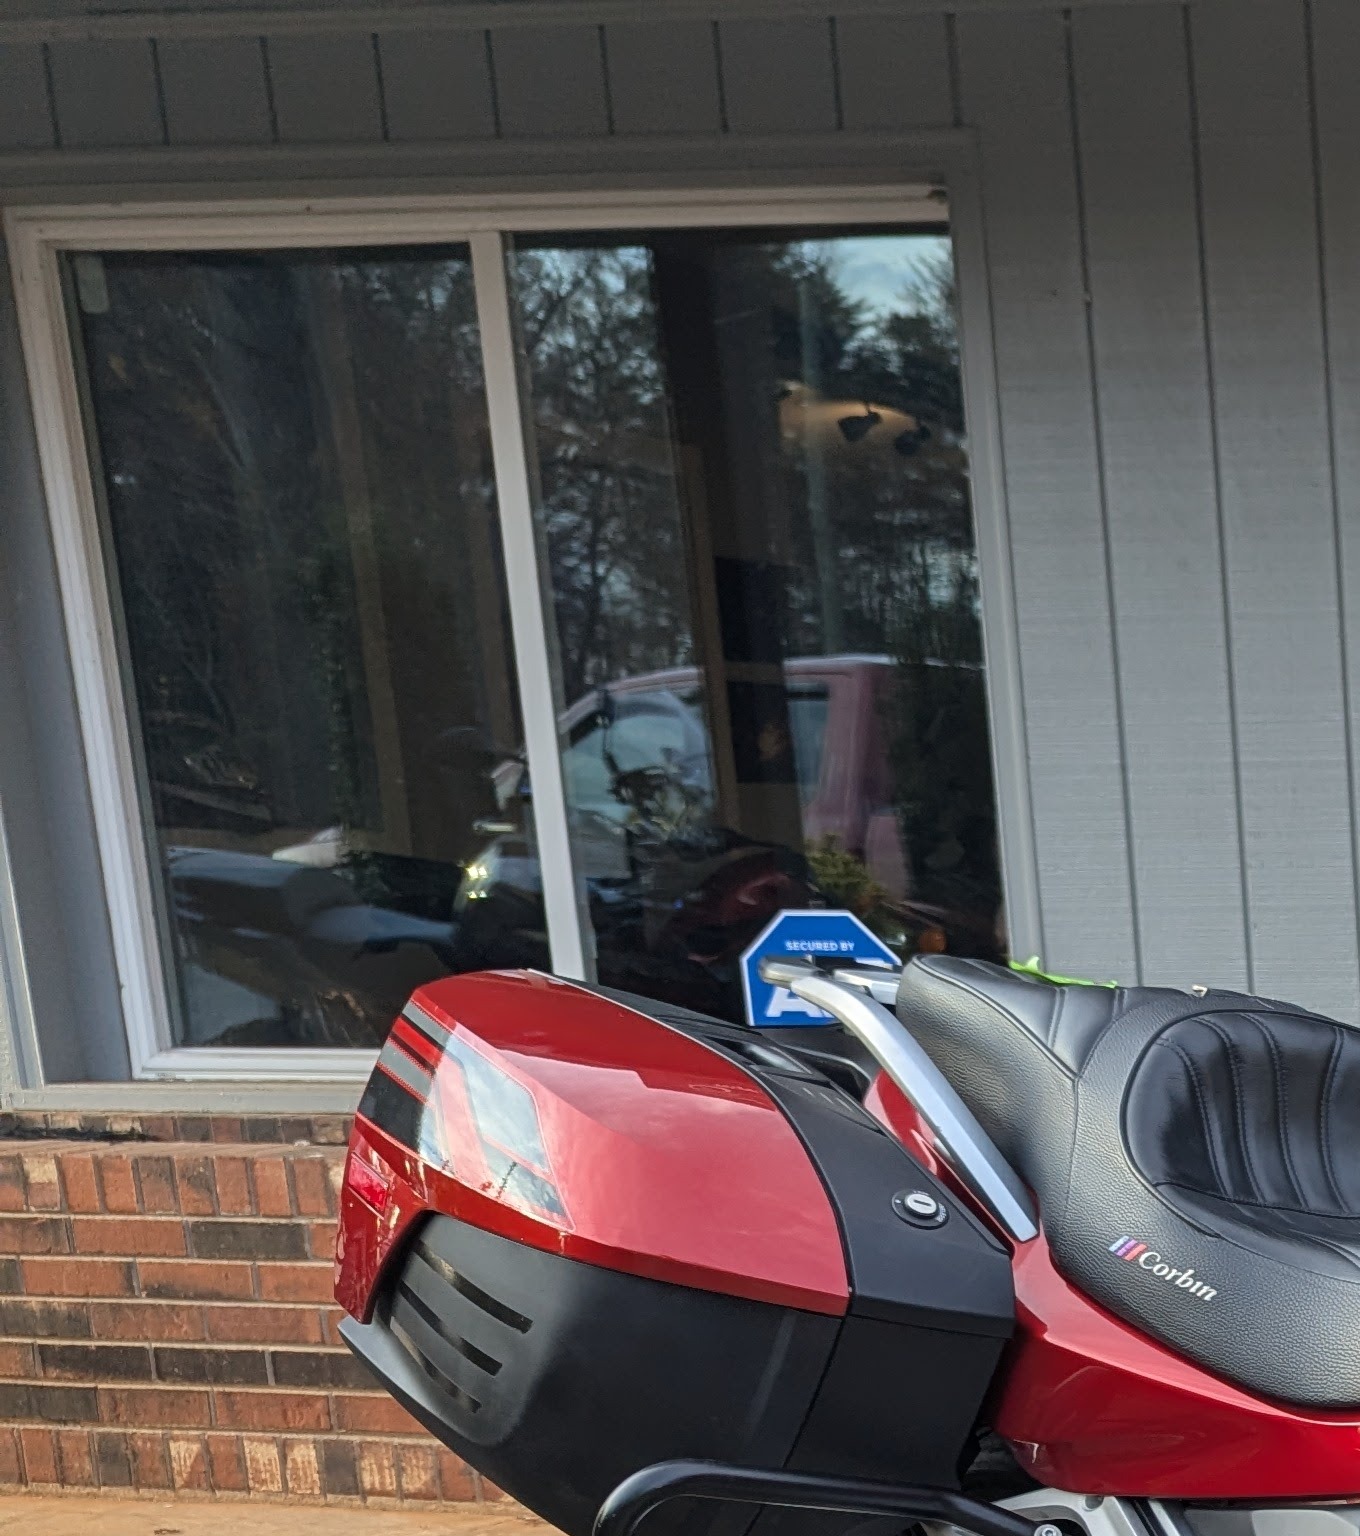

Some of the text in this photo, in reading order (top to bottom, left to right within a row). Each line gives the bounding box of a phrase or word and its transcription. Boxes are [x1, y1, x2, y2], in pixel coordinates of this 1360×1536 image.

[785, 940, 855, 951] SECURED BY
[1138, 1251, 1218, 1301] Corbin
